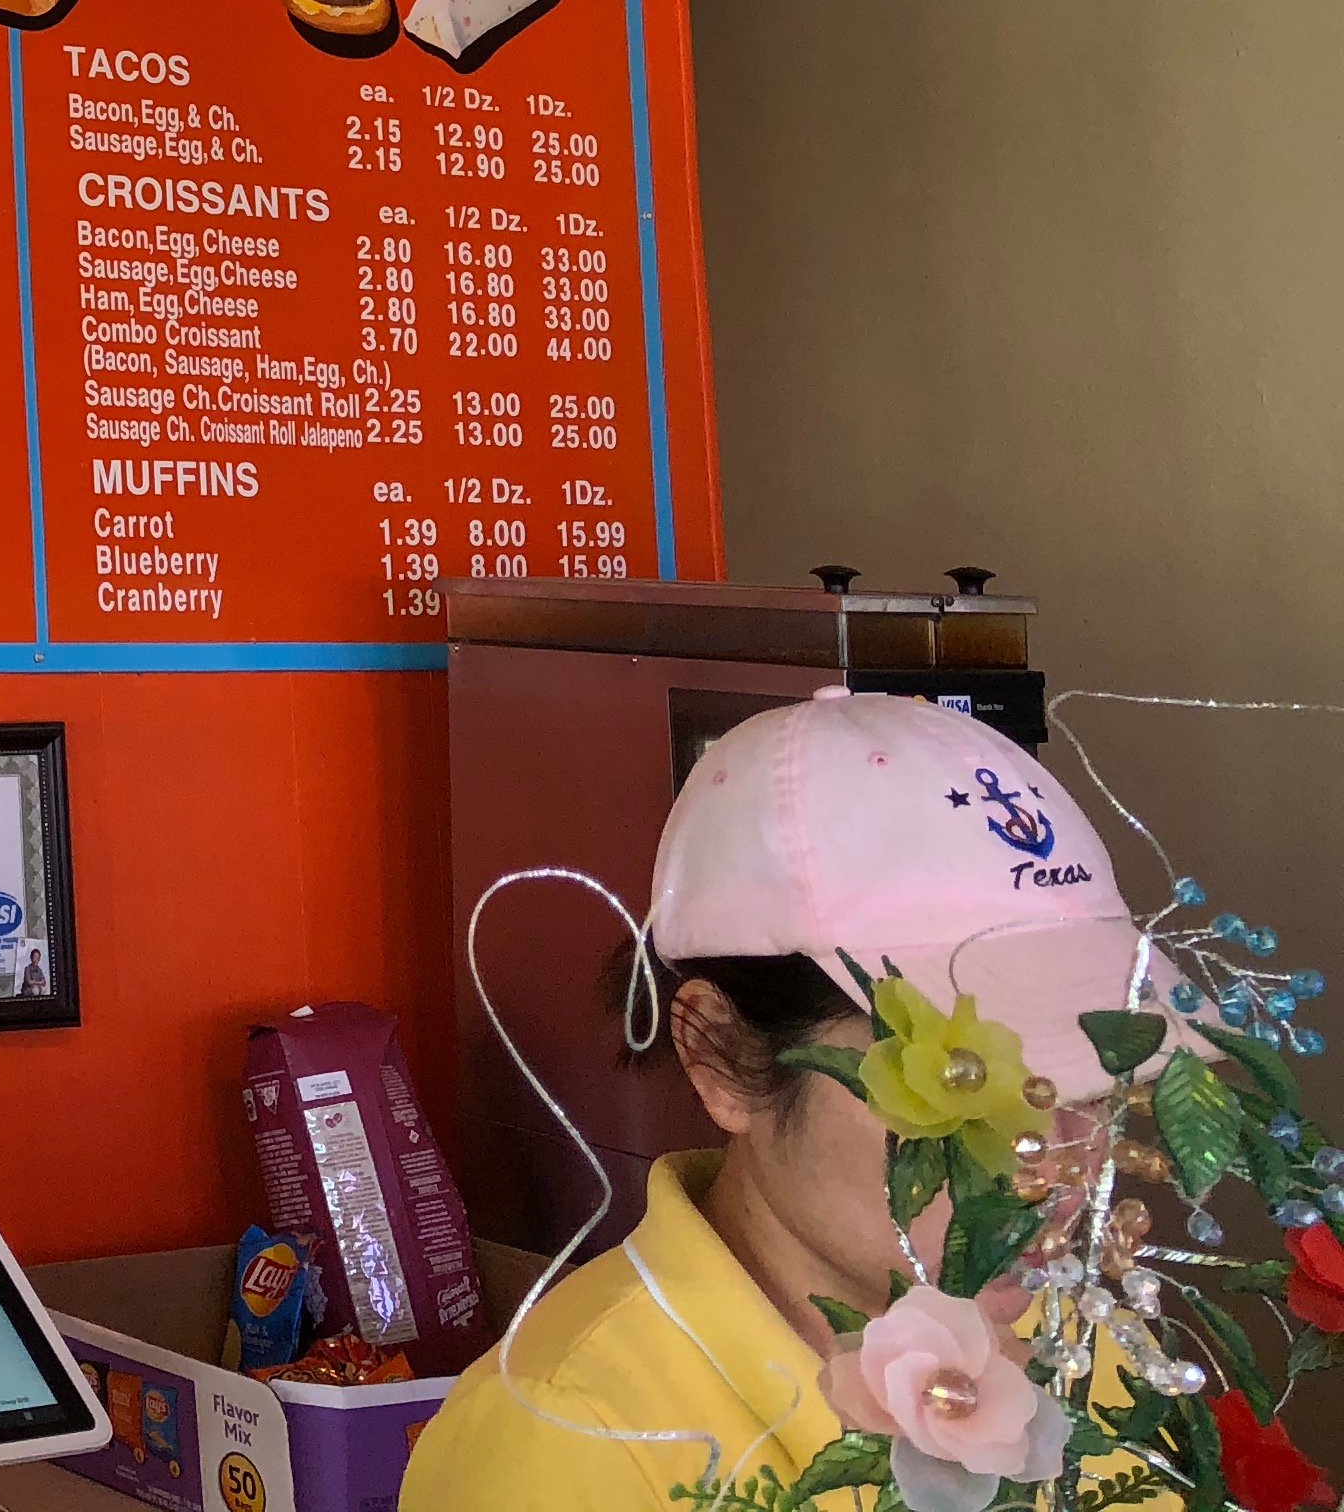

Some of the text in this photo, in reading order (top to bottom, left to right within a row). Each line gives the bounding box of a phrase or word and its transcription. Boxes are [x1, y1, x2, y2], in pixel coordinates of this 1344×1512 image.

[64, 46, 189, 85] TACOS
[79, 173, 329, 221] CROISSANTS
[82, 316, 260, 348] Combo Croissant
[93, 460, 612, 505] MUFFINS ea. 1/2 Dz. 1Dz.
[95, 508, 624, 547] Carrot 1.39 8.00 15.99
[97, 546, 218, 582] Blueberry
[99, 582, 222, 618] Cranberry
[1010, 861, 1092, 889] Texas
[213, 1394, 259, 1426] Flavor
[224, 1420, 251, 1447] Mix
[229, 1465, 256, 1500] 50
